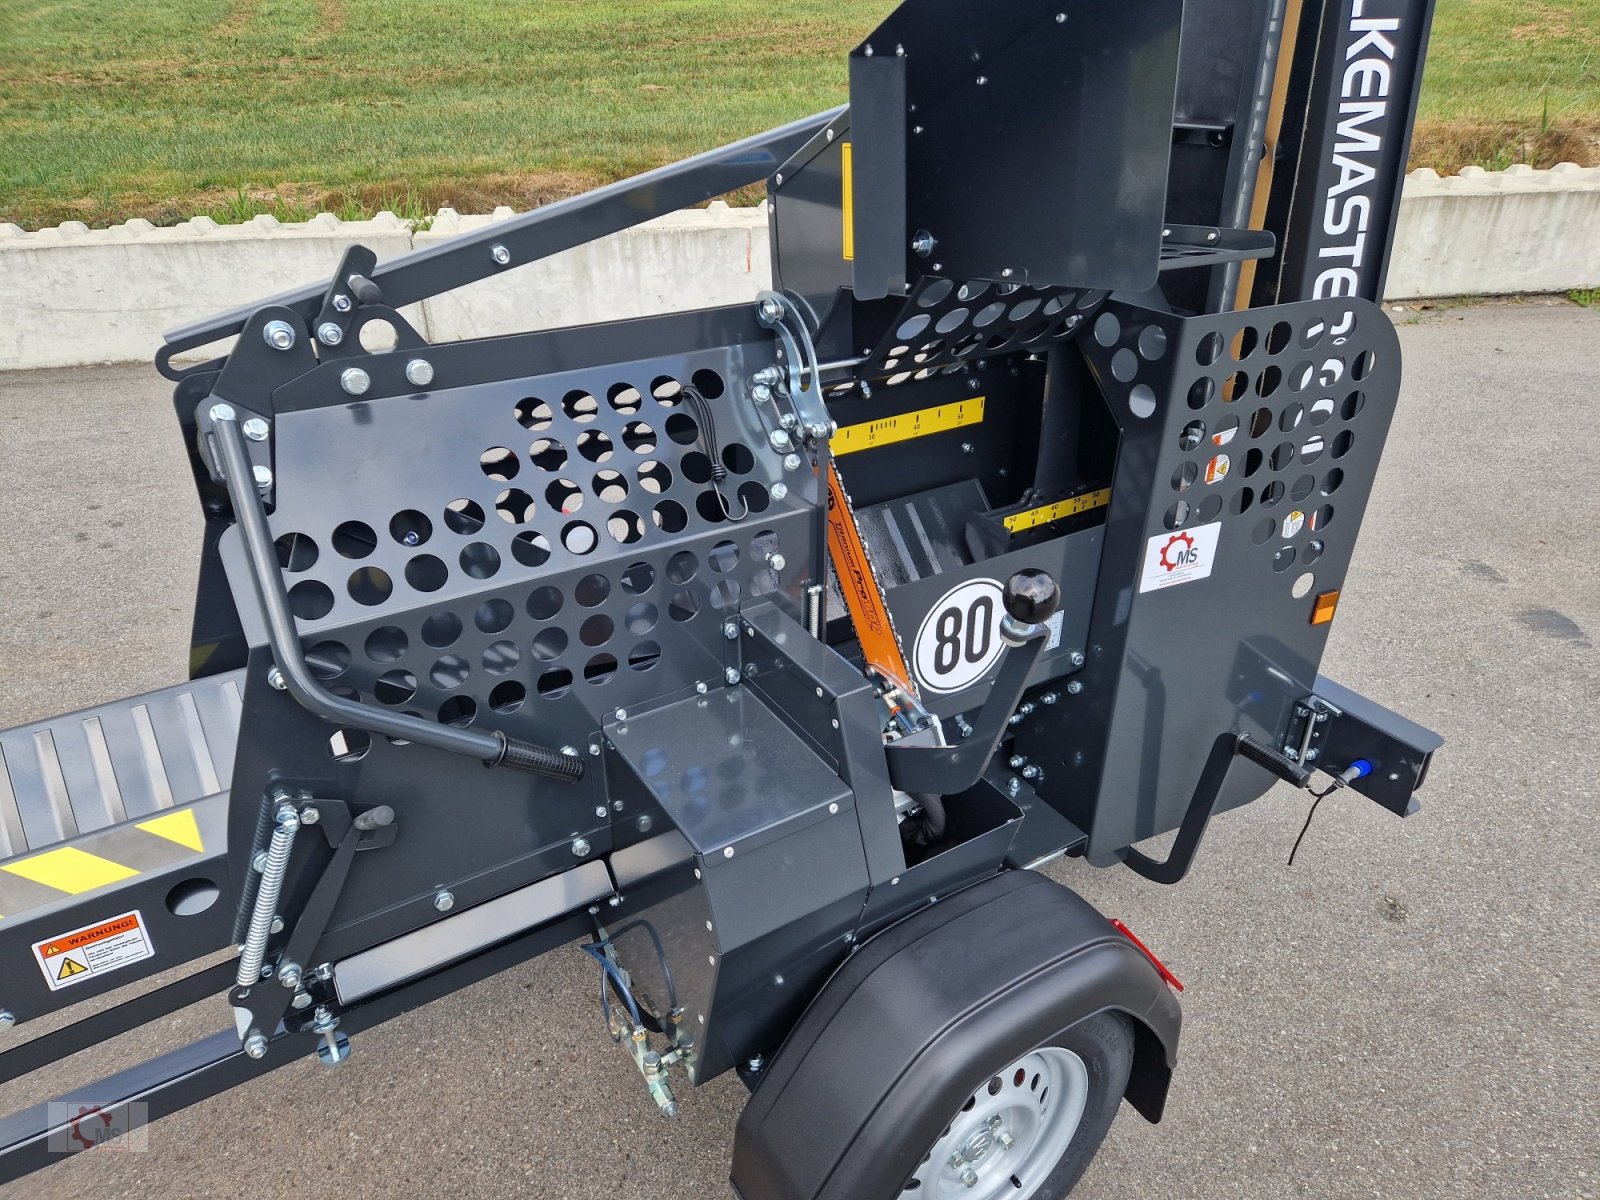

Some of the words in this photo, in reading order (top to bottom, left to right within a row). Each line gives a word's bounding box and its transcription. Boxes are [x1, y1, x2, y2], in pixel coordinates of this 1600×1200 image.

[835, 521, 855, 570] Titanium
[1177, 547, 1198, 566] MS
[934, 595, 993, 675] 80
[68, 919, 133, 946] WARNUNG!
